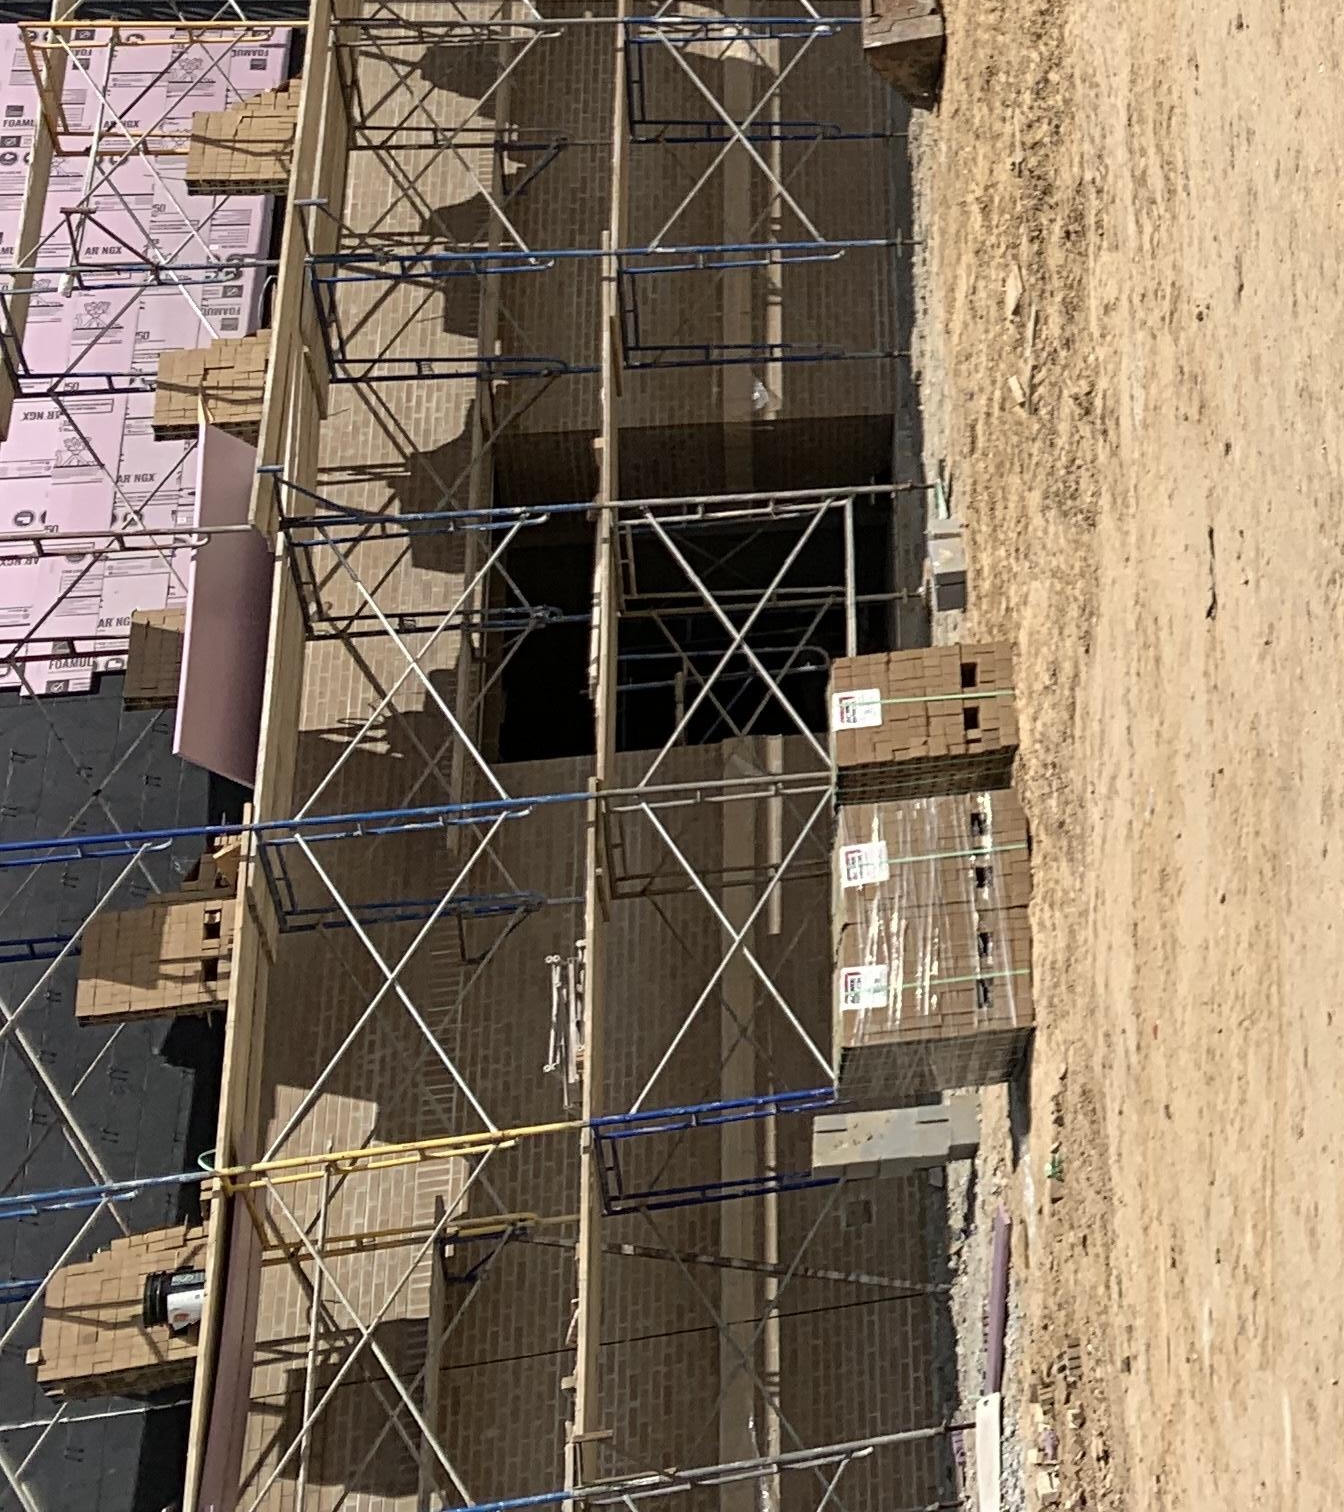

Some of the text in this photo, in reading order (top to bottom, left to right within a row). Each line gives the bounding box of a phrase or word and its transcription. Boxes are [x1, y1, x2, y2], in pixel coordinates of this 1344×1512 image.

[84, 247, 99, 255] AR
[22, 412, 44, 421] NGX
[133, 473, 157, 482] NGX
[97, 618, 113, 628] AR
